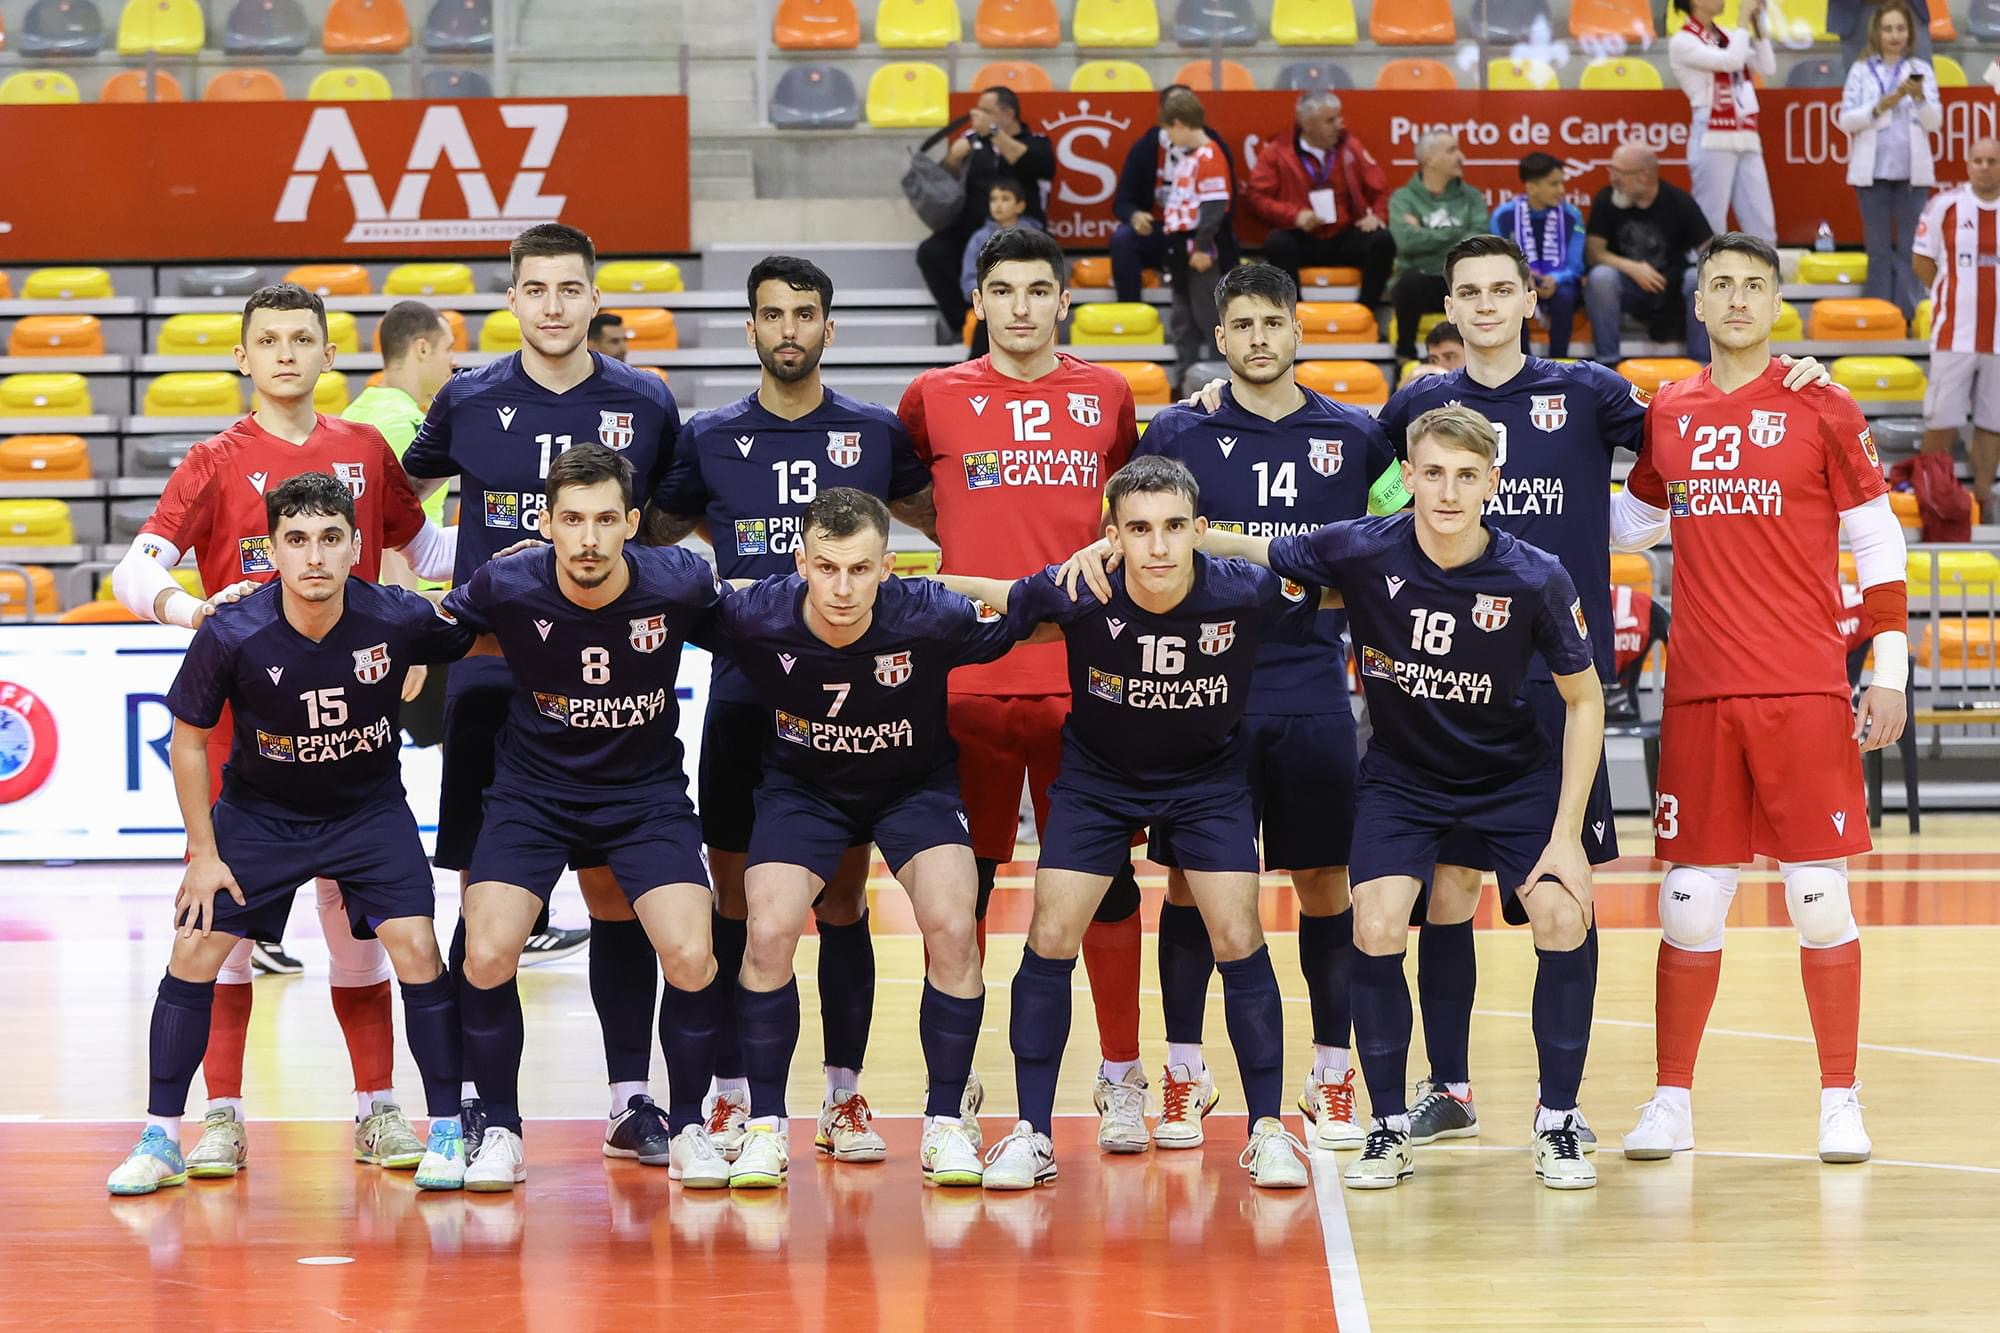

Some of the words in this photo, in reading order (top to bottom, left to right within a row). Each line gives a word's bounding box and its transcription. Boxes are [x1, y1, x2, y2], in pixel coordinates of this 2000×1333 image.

[1508, 114, 1550, 145] de
[1560, 116, 1689, 152] Cartage
[1785, 101, 1853, 164] LOS
[1005, 399, 1052, 441] 12
[1001, 449, 1098, 466] PRIMARIA
[1690, 425, 1741, 471] 23
[772, 460, 817, 504] 13
[1003, 464, 1098, 488] GALATI
[1251, 461, 1298, 507] 14
[1383, 477, 1403, 500] RESP
[1495, 478, 1564, 495] MARIA
[1688, 478, 1782, 495] PRIMARIA
[1480, 493, 1564, 516] ALATI
[1689, 495, 1782, 516] GALATI
[1410, 608, 1457, 656] 18
[580, 646, 611, 685] 8
[1137, 634, 1187, 675] 16
[1128, 674, 1228, 694] PRIMARIA
[1394, 660, 1492, 688] PRIMARIA
[1396, 674, 1493, 704] GALATI
[299, 686, 348, 729] 15
[569, 687, 666, 713] PRIMARIA
[569, 697, 666, 729] GALATI
[822, 682, 851, 718] 7
[1127, 685, 1228, 709] GALATI
[296, 716, 390, 748] PRIMARIA
[298, 725, 392, 763] GALATI
[811, 718, 912, 739] PRIMARIA
[812, 729, 913, 754] GALATI
[1655, 791, 1679, 840] 3
